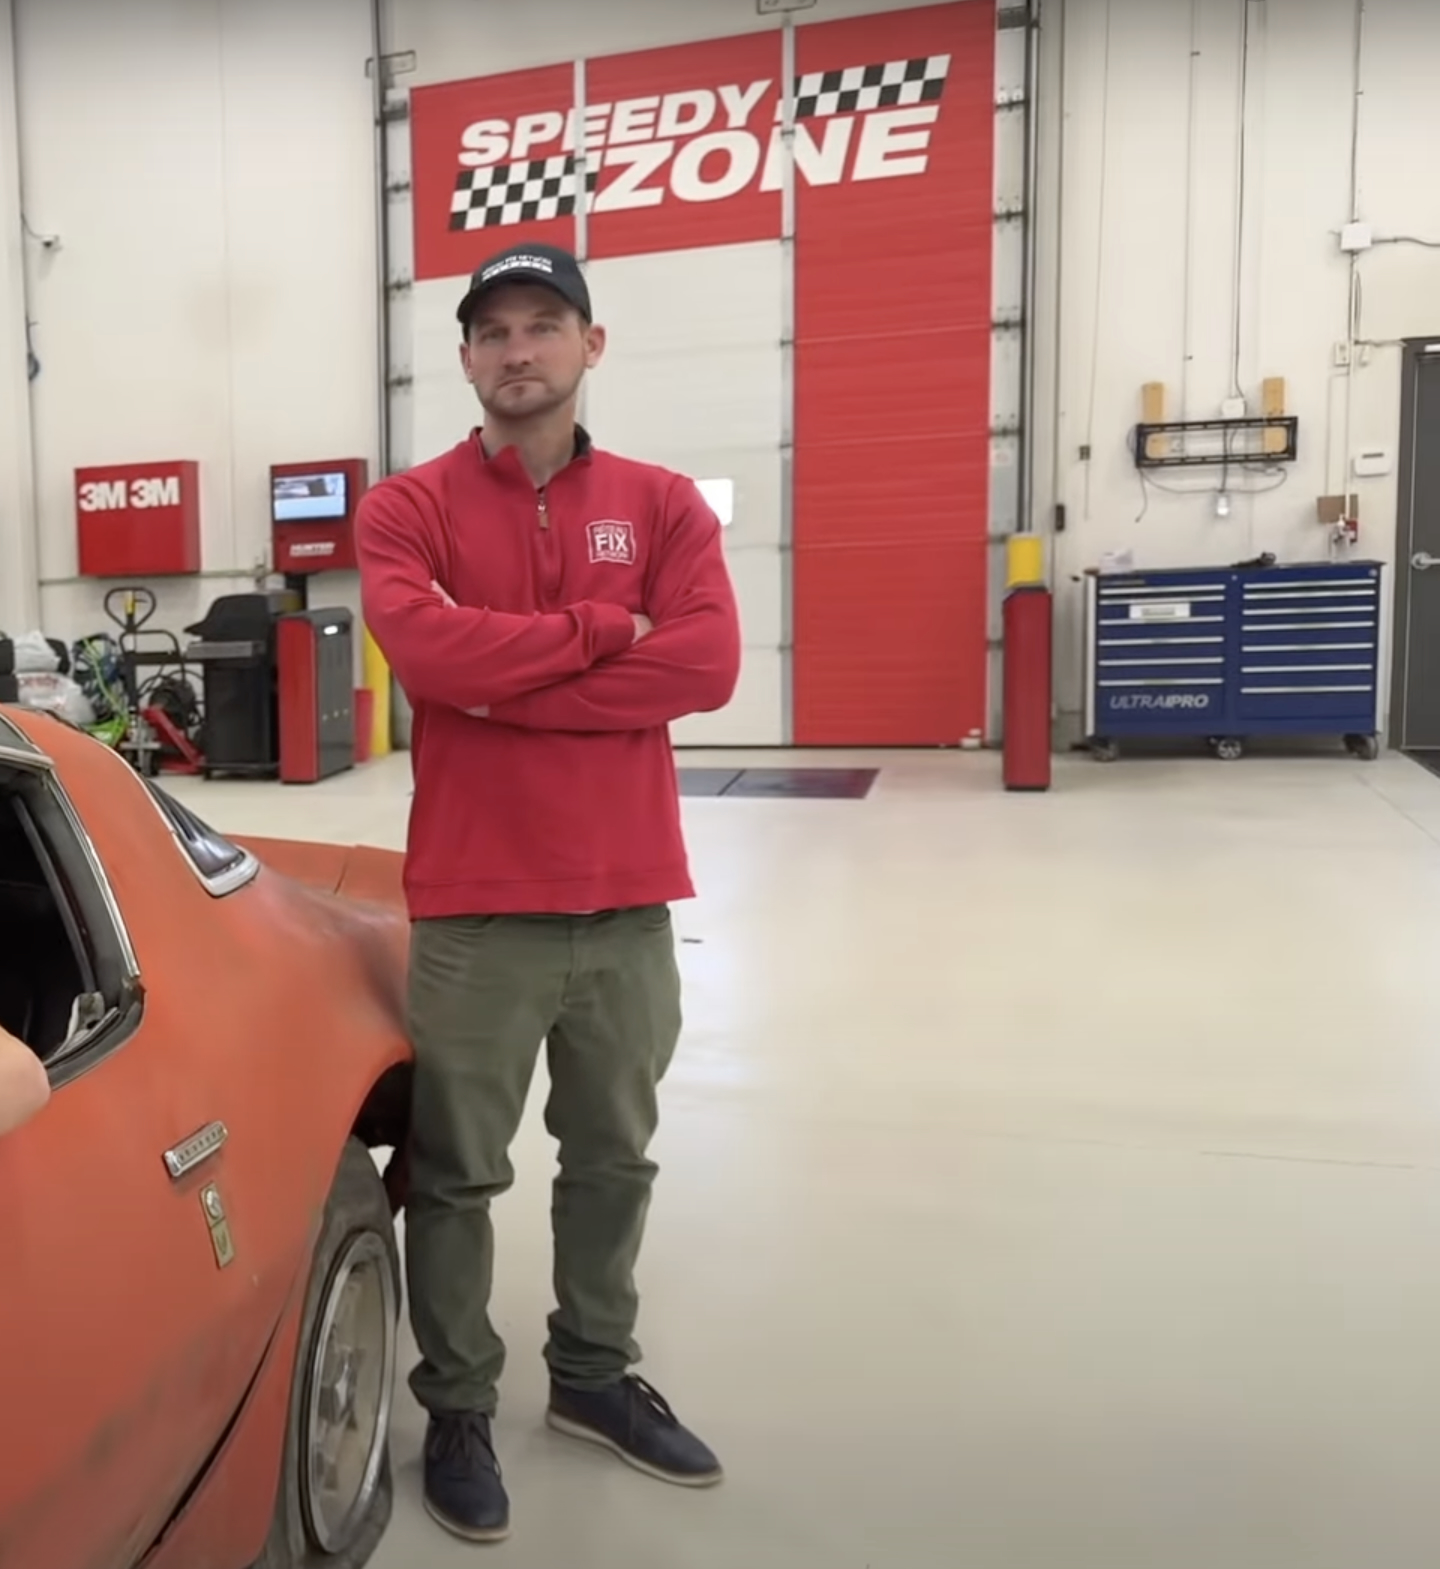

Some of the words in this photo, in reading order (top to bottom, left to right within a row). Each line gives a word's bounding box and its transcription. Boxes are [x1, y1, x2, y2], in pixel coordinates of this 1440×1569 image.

[458, 78, 773, 166] SPEEDY
[591, 105, 940, 213] ZONE
[79, 480, 127, 512] 3M
[129, 476, 180, 509] 3M
[595, 533, 628, 551] FIX
